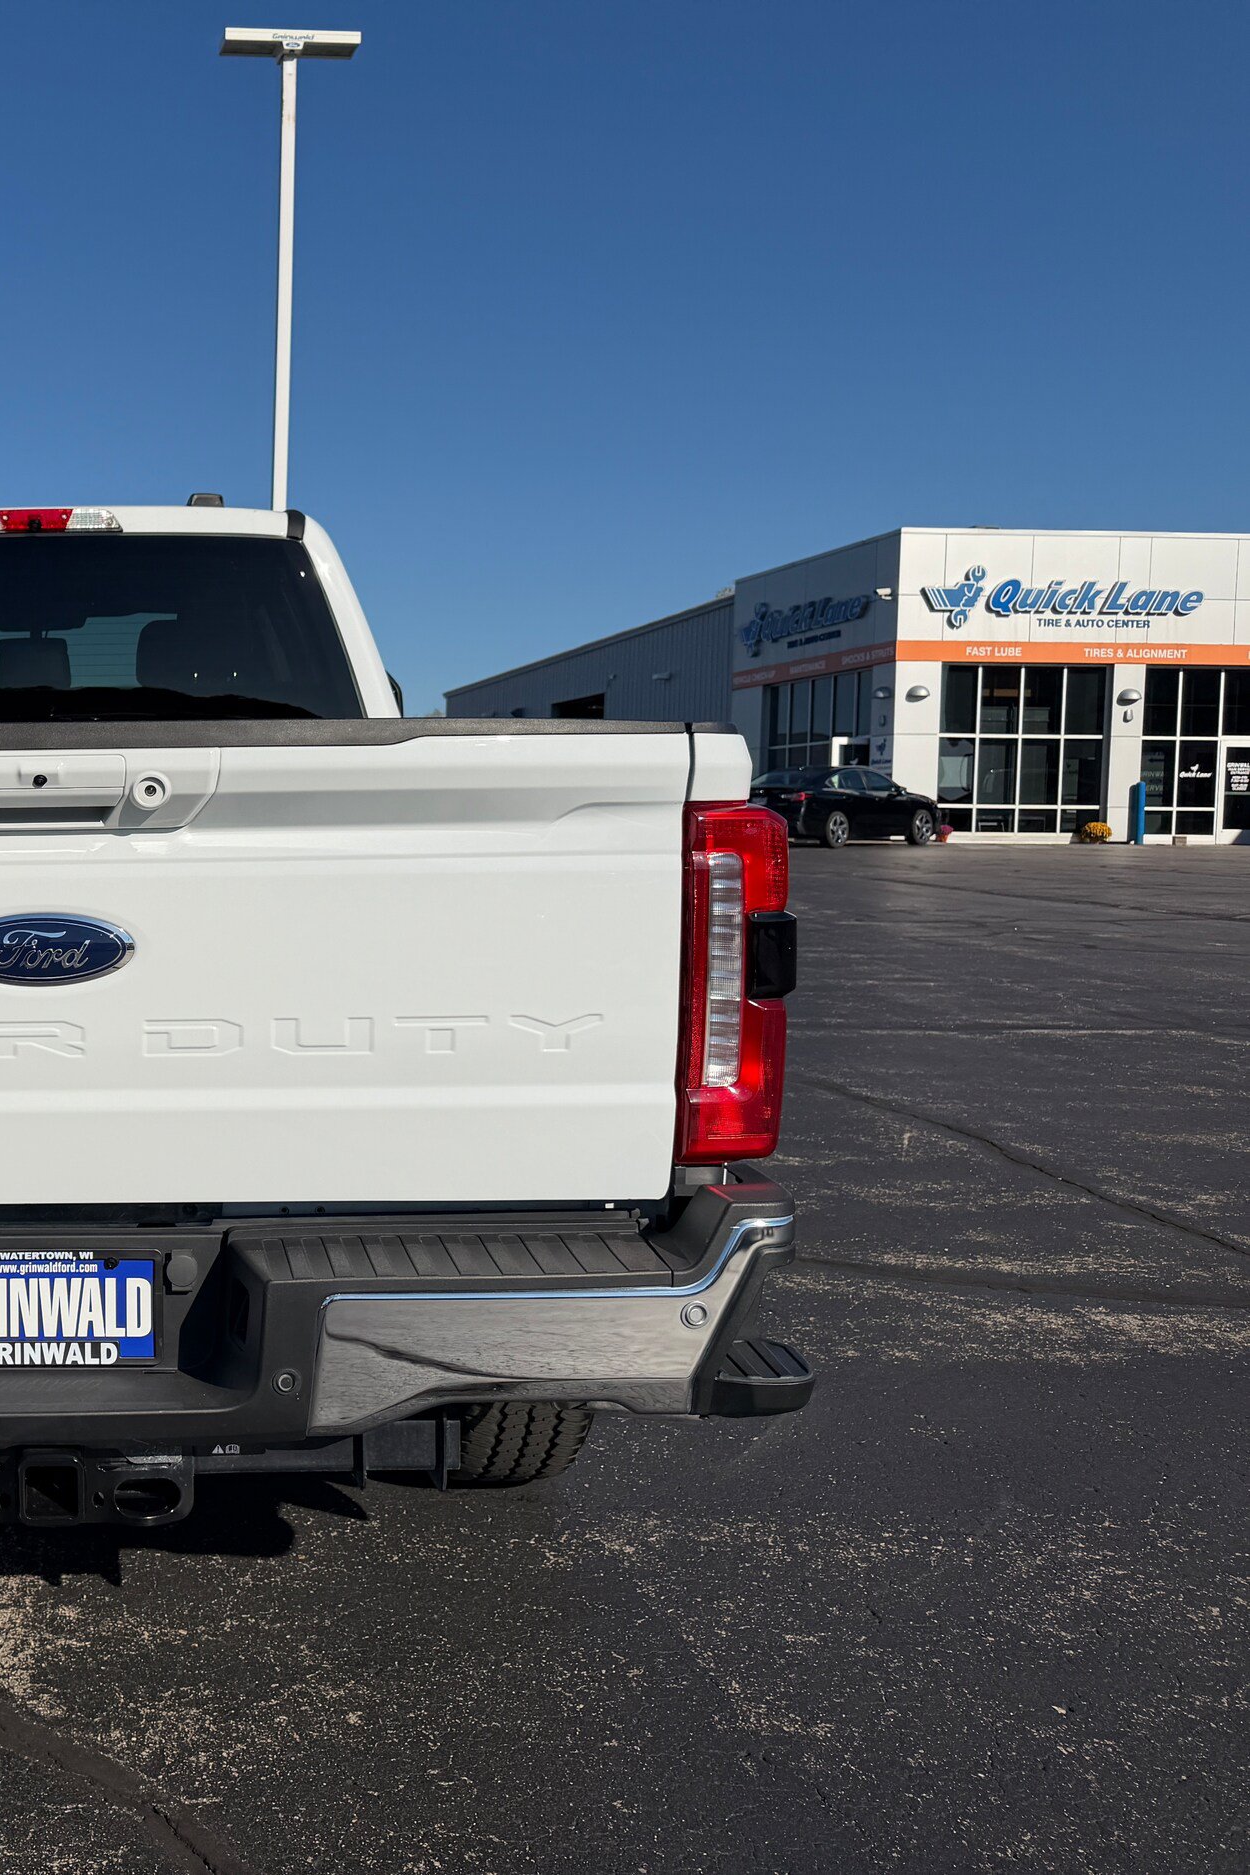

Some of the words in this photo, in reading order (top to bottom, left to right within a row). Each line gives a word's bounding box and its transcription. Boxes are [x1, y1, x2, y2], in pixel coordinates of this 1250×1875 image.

[986, 579, 1104, 617] Quick
[1097, 580, 1204, 617] Lane
[812, 595, 869, 629] Lane
[1037, 618, 1061, 627] TIRE
[1064, 618, 1072, 628] &
[1075, 619, 1104, 628] AUTO
[1107, 619, 1150, 629] CENTER
[966, 646, 992, 656] FAST
[995, 647, 1022, 657] LUBE
[1084, 648, 1113, 658] TIRES
[1116, 648, 1123, 658] &
[1126, 649, 1187, 659] ALIGNMENT
[142, 1013, 604, 1058] DUTY
[0, 1251, 76, 1261] WATERTOWN,
[79, 1251, 94, 1260] WI
